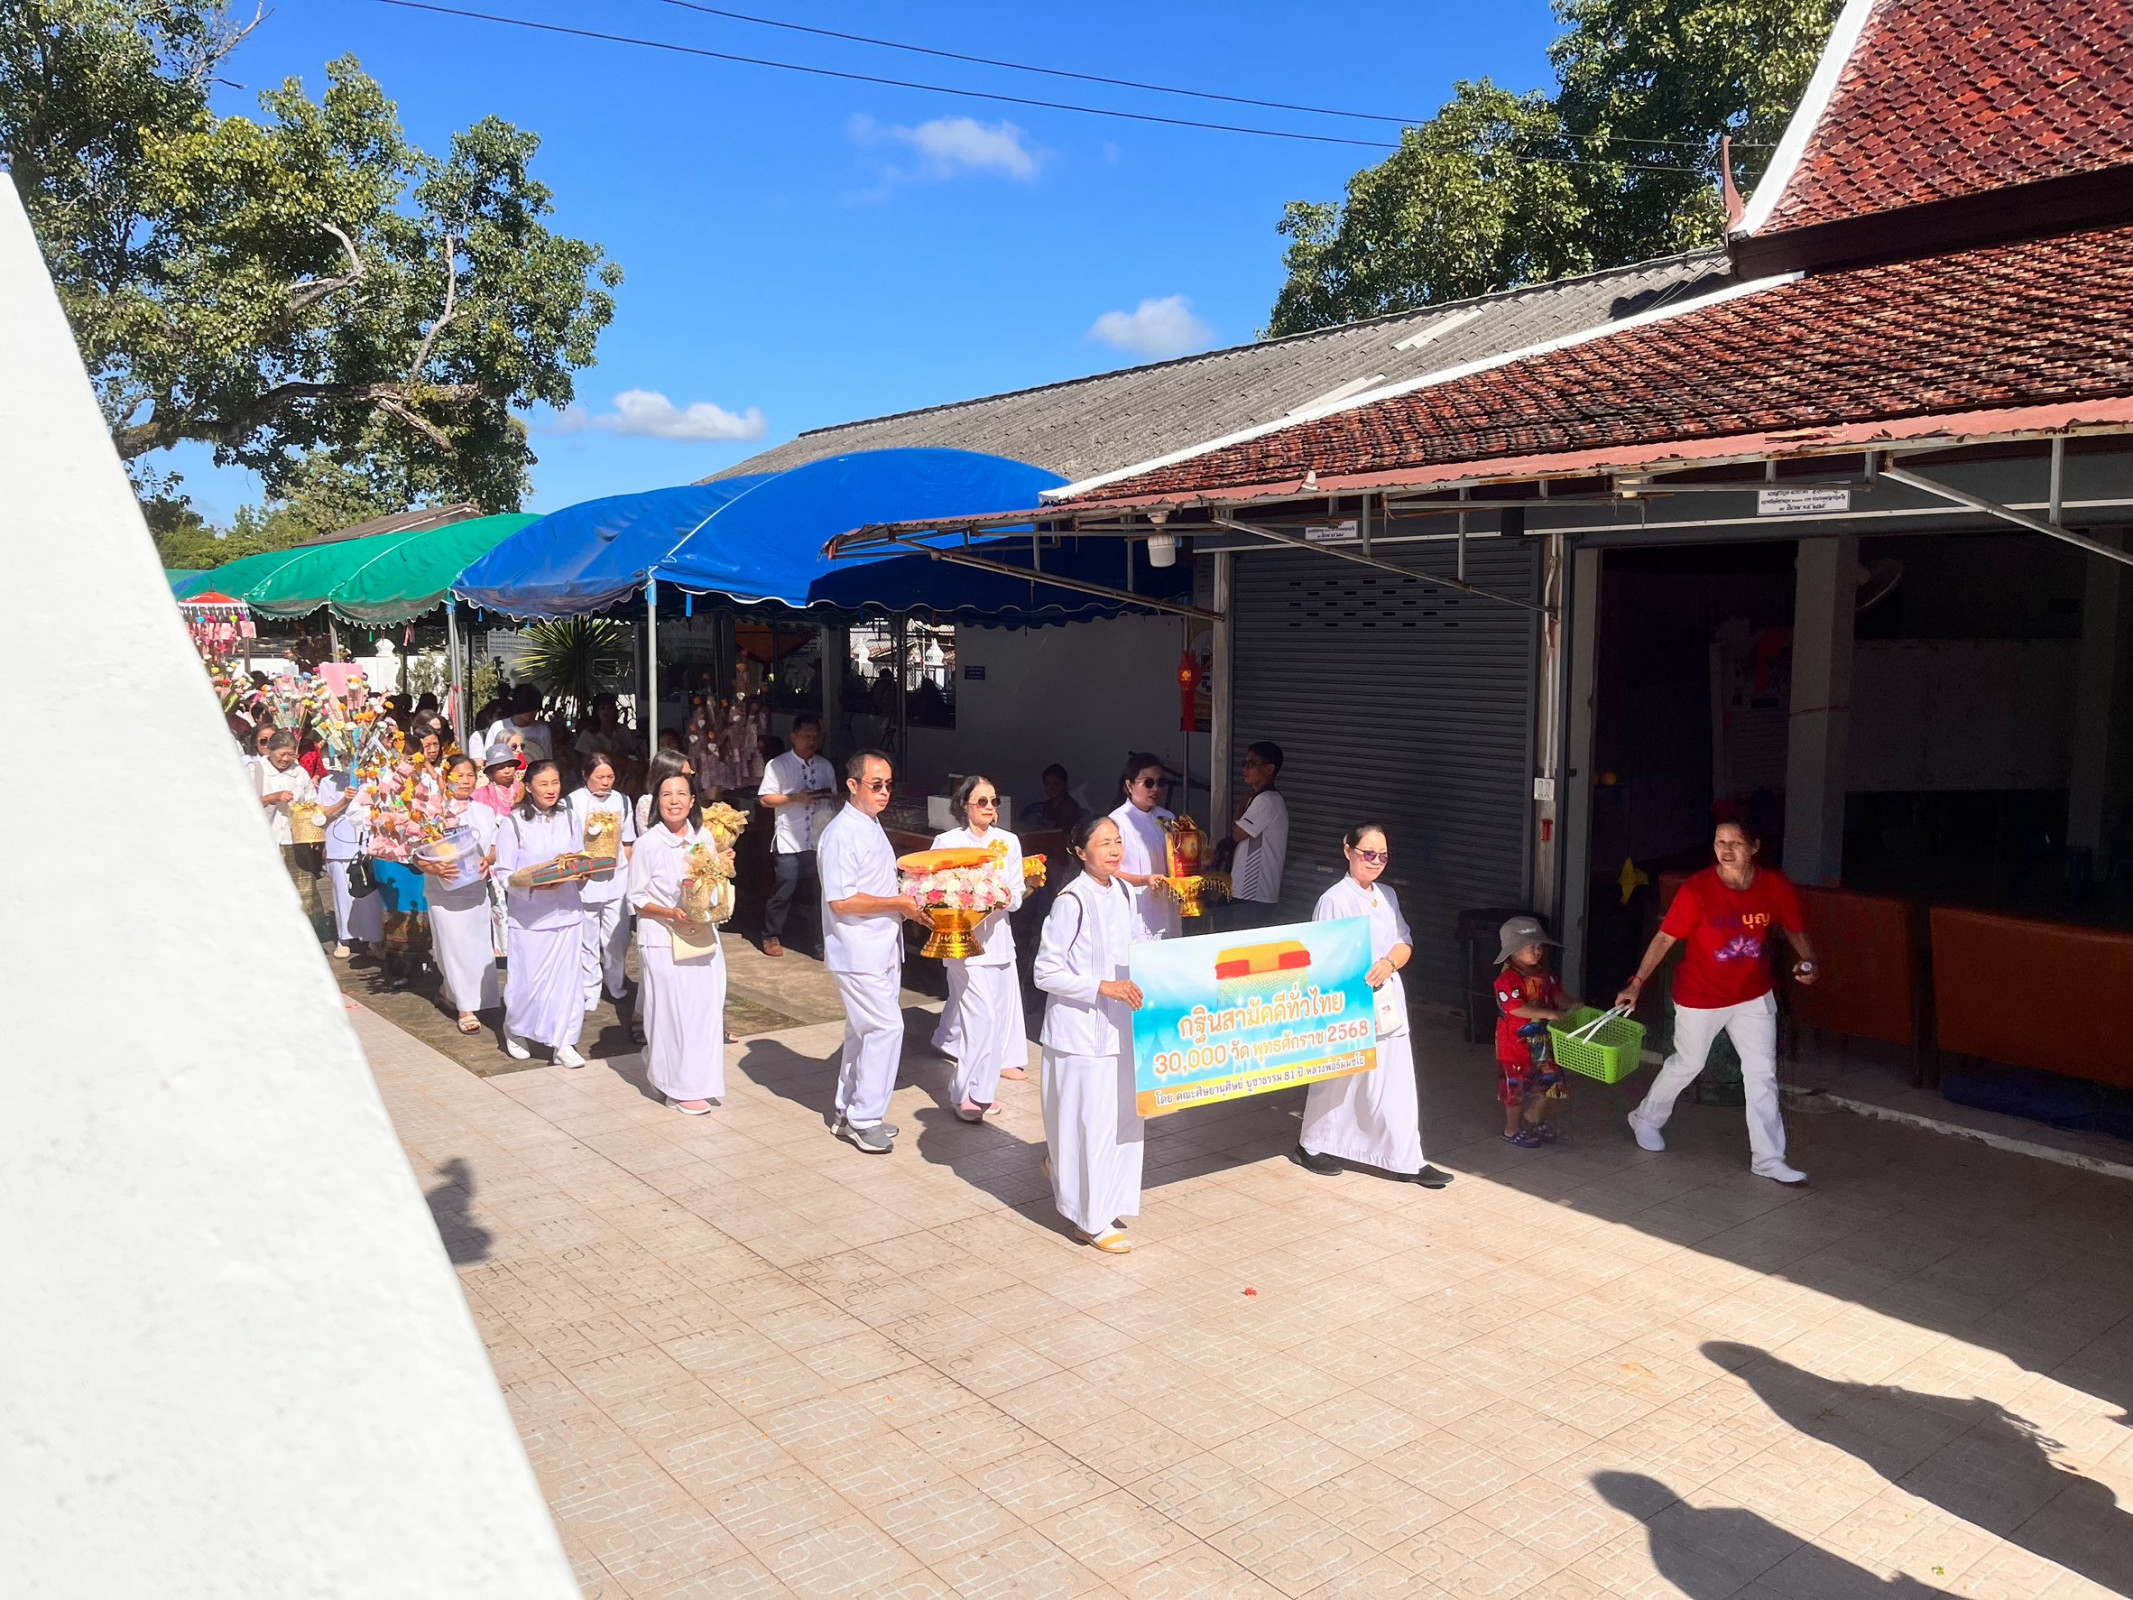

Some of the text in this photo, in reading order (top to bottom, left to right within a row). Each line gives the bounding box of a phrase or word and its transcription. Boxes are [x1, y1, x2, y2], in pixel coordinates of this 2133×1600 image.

[1741, 911, 1770, 930] บุญ
[1179, 983, 1344, 1044] กฐินสามัคคีทั่วไทย
[1155, 1020, 1369, 1075] 30,000 วัด พุทธศักราช 2568
[1155, 1091, 1173, 1105] โดย
[1176, 1077, 1244, 1102] คณะศิษยานุศิษย์
[1246, 1073, 1282, 1091] บูชาธรรม
[1284, 1070, 1295, 1081] 81
[1297, 1066, 1304, 1077] ปี
